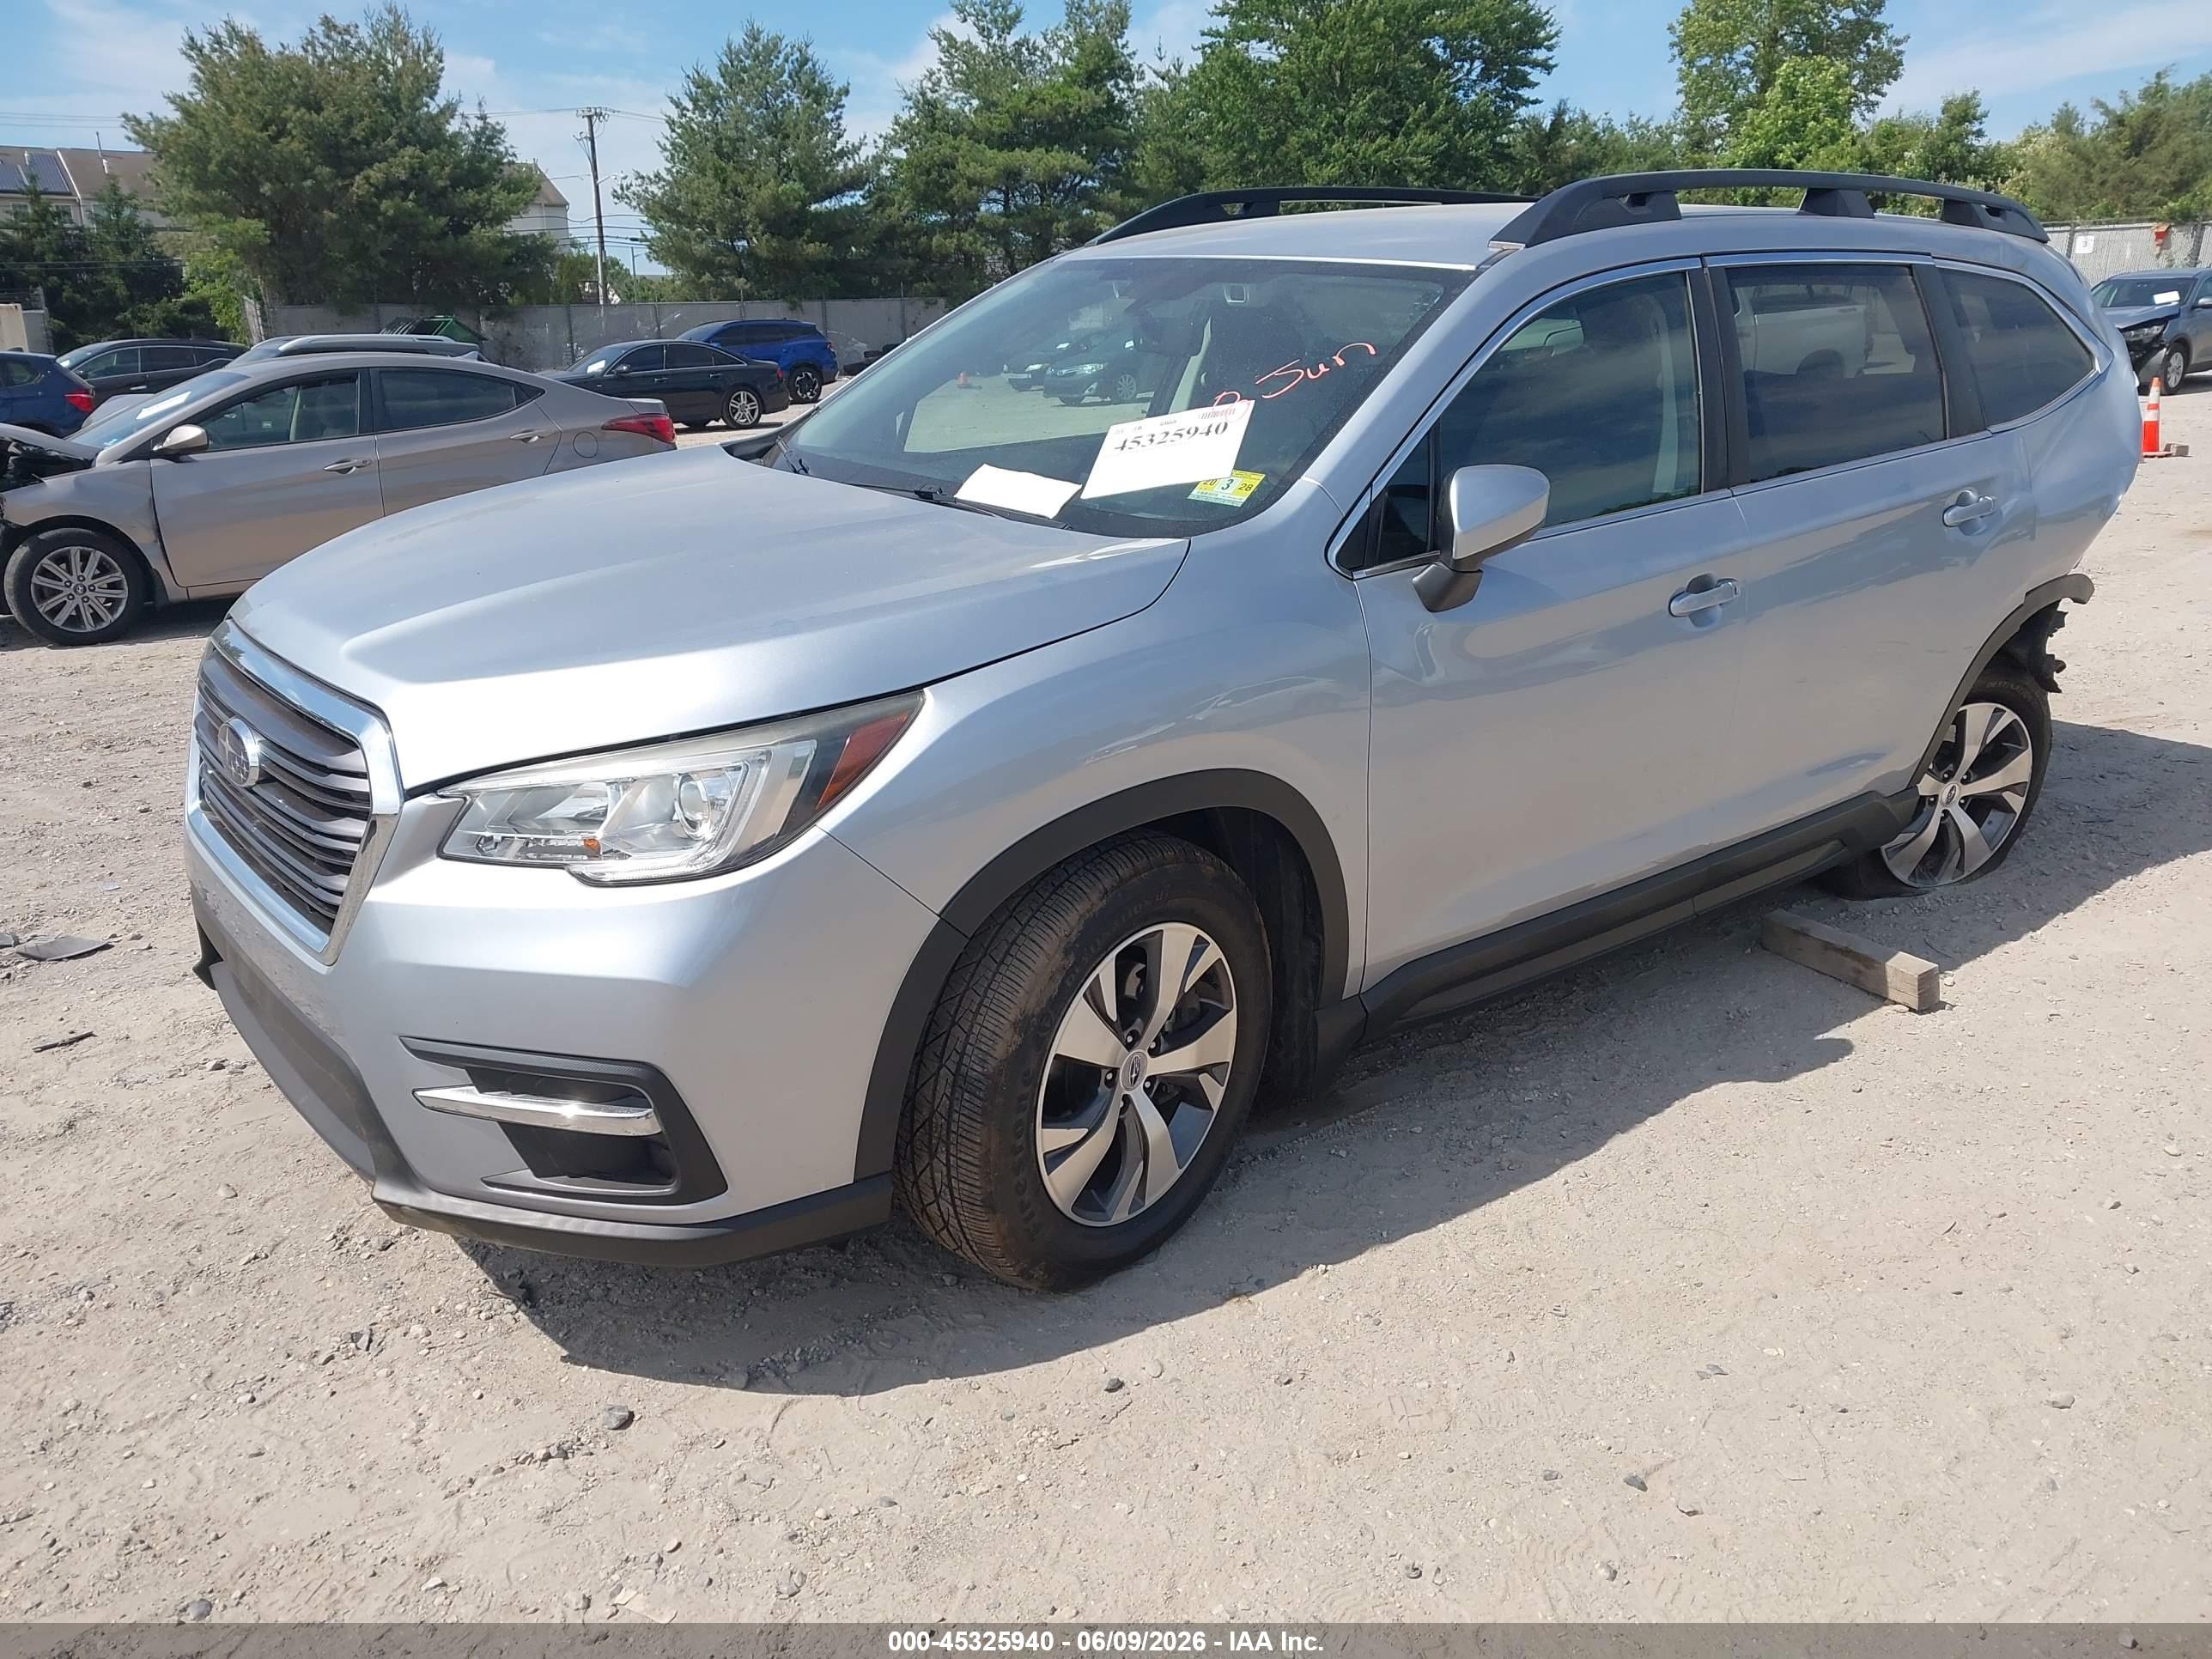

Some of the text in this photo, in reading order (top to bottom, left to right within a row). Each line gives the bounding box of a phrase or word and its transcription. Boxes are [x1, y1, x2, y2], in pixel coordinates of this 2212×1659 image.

[1115, 421, 1229, 452] 45325940
[1221, 479, 1234, 490] 3
[1237, 483, 1254, 492] 28
